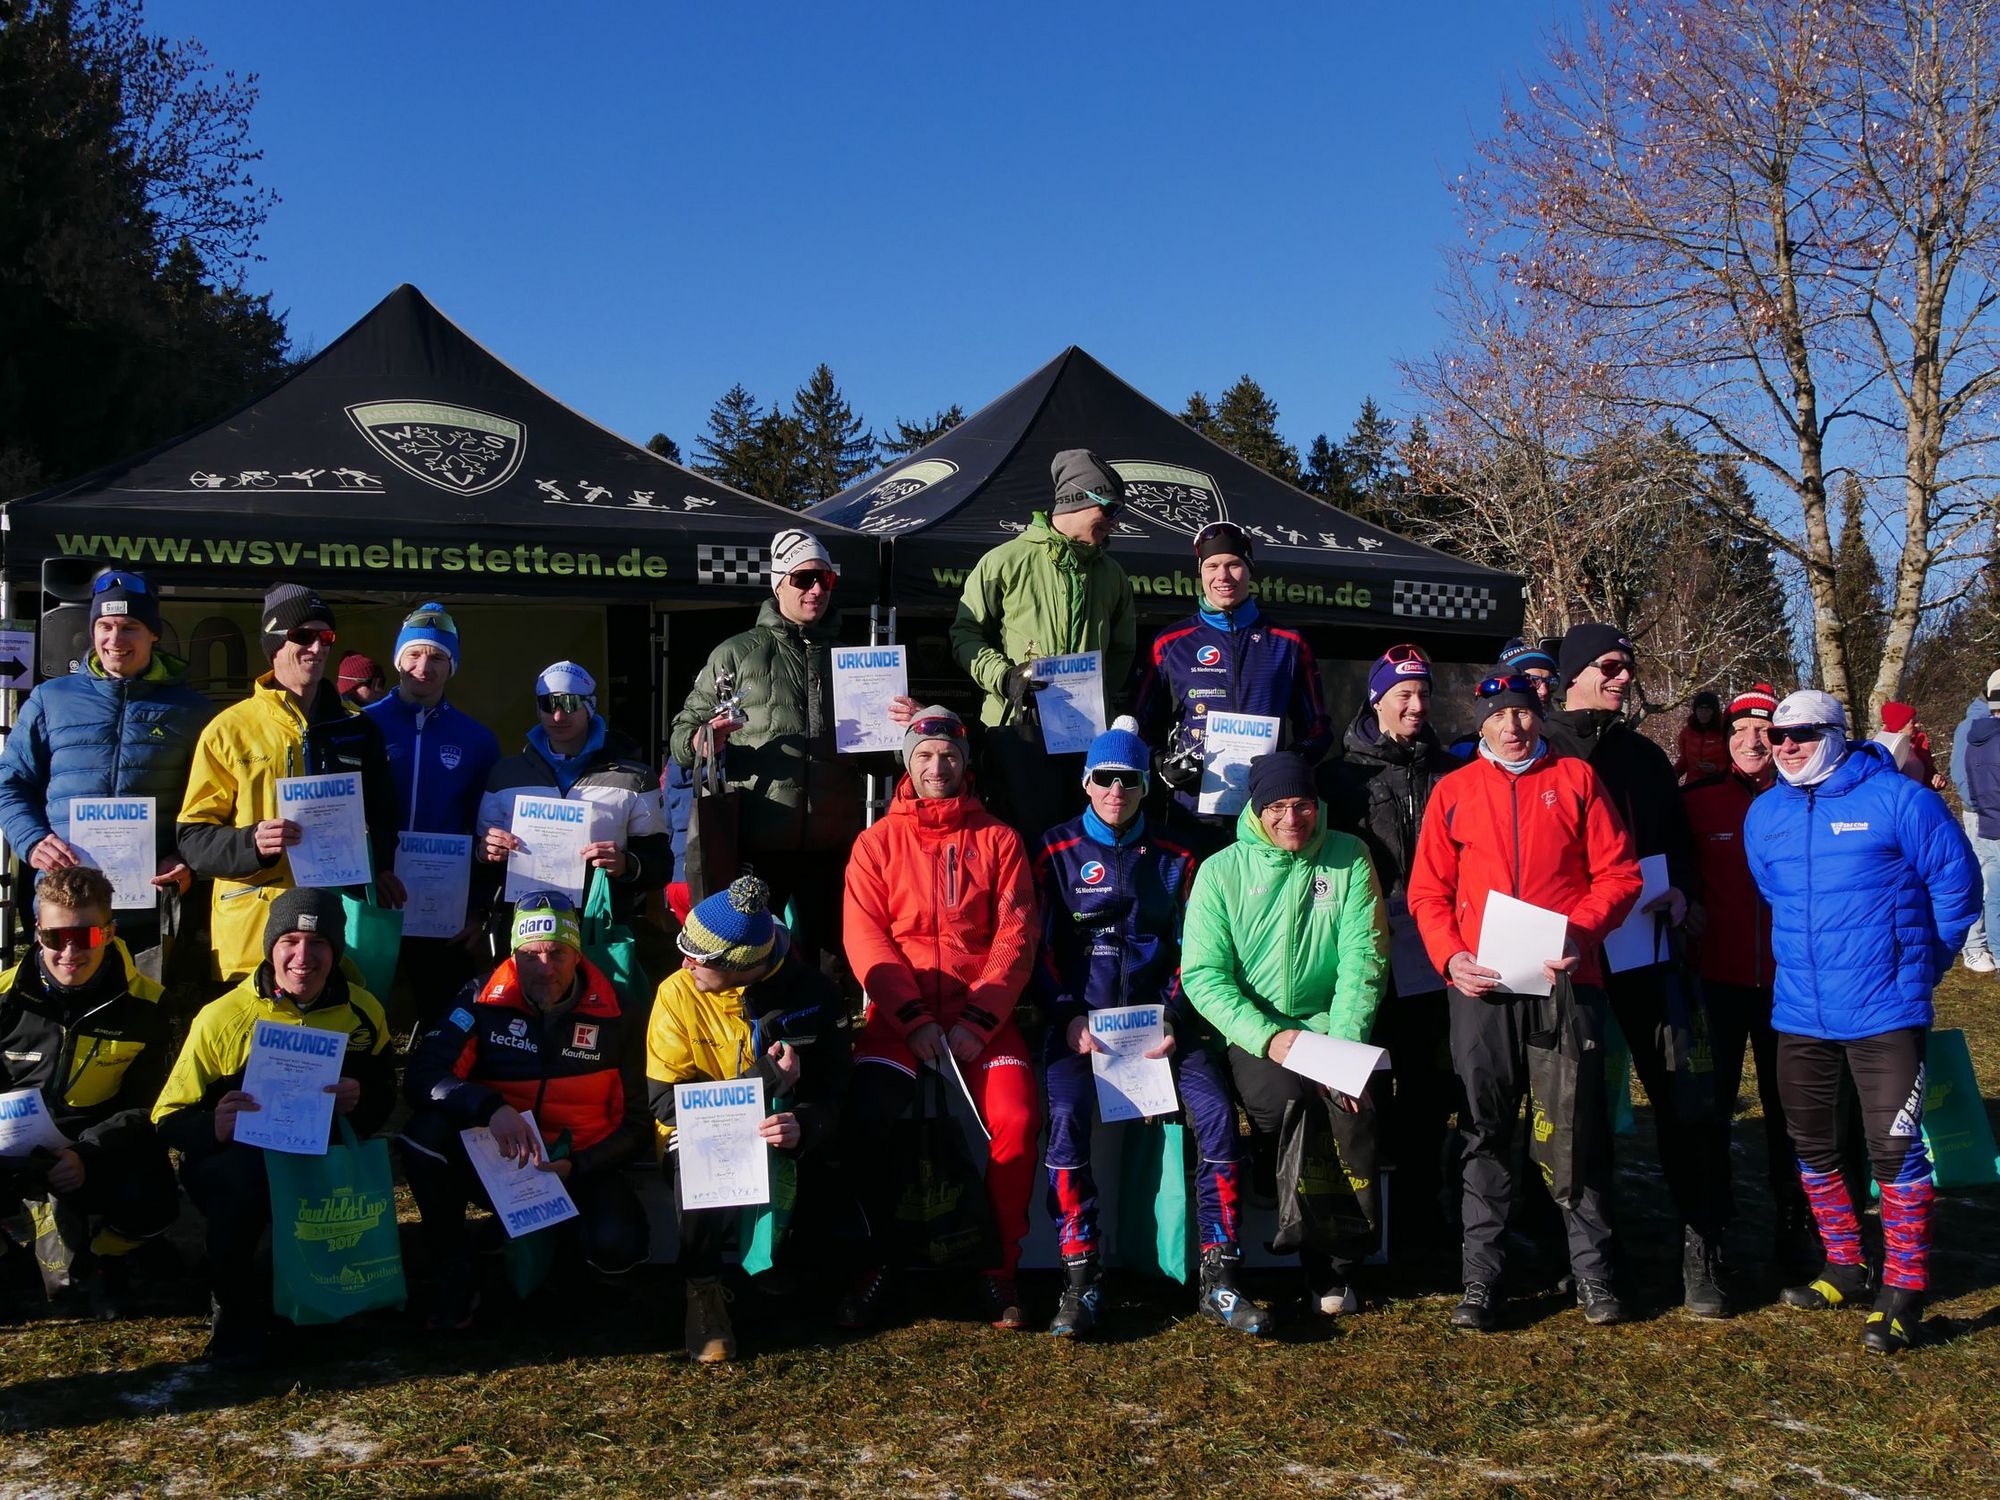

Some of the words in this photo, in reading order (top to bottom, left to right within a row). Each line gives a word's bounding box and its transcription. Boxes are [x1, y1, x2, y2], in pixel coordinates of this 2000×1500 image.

[55, 533, 669, 579] www.wsv-mehrstetten.de
[836, 651, 900, 670] URKUNDE
[1036, 656, 1097, 677] URKUNDE
[1211, 717, 1274, 739] URKUNDE
[282, 778, 356, 802] URKUNDE
[76, 803, 149, 821] URKUNDE
[519, 801, 586, 823] URKUNDE
[401, 836, 466, 857] URKUNDE
[519, 919, 552, 936] claro
[1094, 1009, 1158, 1032] URKUNDE
[258, 1026, 340, 1058] URKUNDE
[489, 1031, 539, 1054] tectake
[561, 1047, 601, 1062] Kaufland
[0, 1096, 39, 1120] UNDE
[681, 1085, 756, 1110] URKUNDE
[508, 1197, 571, 1230] URKUNDE
